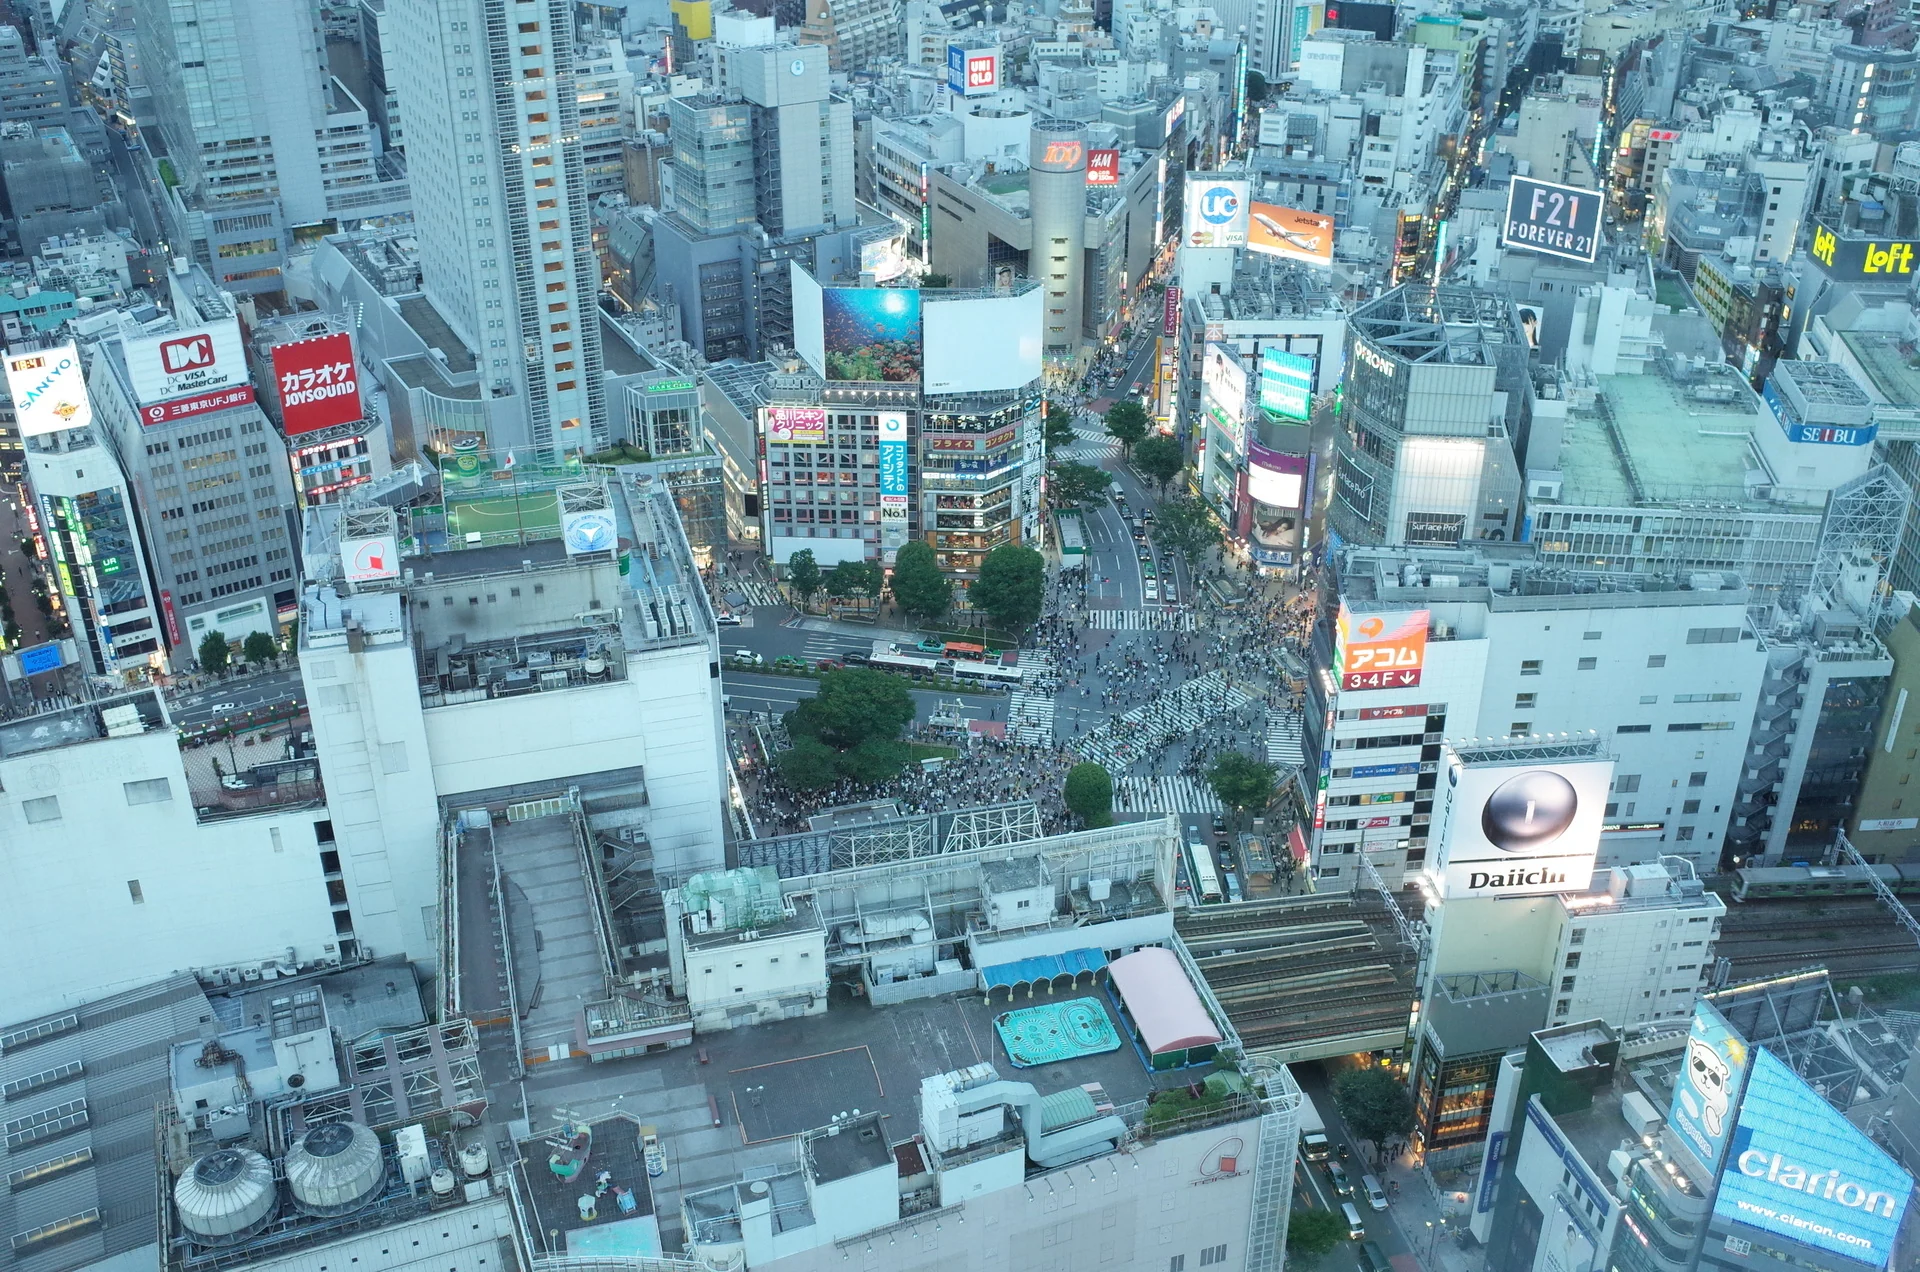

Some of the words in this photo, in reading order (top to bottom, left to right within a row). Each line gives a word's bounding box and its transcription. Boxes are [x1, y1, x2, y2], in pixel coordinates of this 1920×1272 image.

[970, 60, 991, 73] UNI
[970, 71, 993, 86] QLO
[1042, 145, 1082, 169] 109
[1091, 153, 1112, 168] H&M
[1202, 196, 1236, 217] UC
[1530, 188, 1579, 229] F21
[1294, 216, 1320, 227] Jetstar
[1509, 220, 1574, 250] FOREVER
[1575, 235, 1592, 254] 21
[1166, 288, 1178, 334] Essential
[166, 339, 211, 370] DC
[1355, 340, 1395, 378] QFRONT
[19, 359, 71, 411] SANKYO
[160, 385, 175, 396] DC
[177, 374, 228, 391] MasterCard
[167, 374, 182, 384] DC
[184, 370, 206, 380] VISA
[281, 361, 351, 393] カラオケ
[171, 391, 247, 414] 三菱東京UFJ銀行
[285, 381, 356, 408] JOYSOUND
[775, 410, 823, 421] 品川スキン
[776, 420, 824, 430] クリニック
[985, 431, 1015, 447] コンタクト
[1801, 427, 1857, 443] SEIBU
[882, 444, 895, 492] アイシティ
[895, 445, 905, 492] コンタクトの
[697, 476, 721, 484] CITY
[883, 508, 907, 519] No.1
[1412, 521, 1442, 532] Surface
[1443, 523, 1458, 532] Pro
[103, 557, 117, 566] UR
[349, 570, 398, 580] TOKYU
[1351, 647, 1418, 670] アコム
[1674, 1107, 1713, 1159] Coppertone
[1737, 1200, 1872, 1250] www.clarion.com
